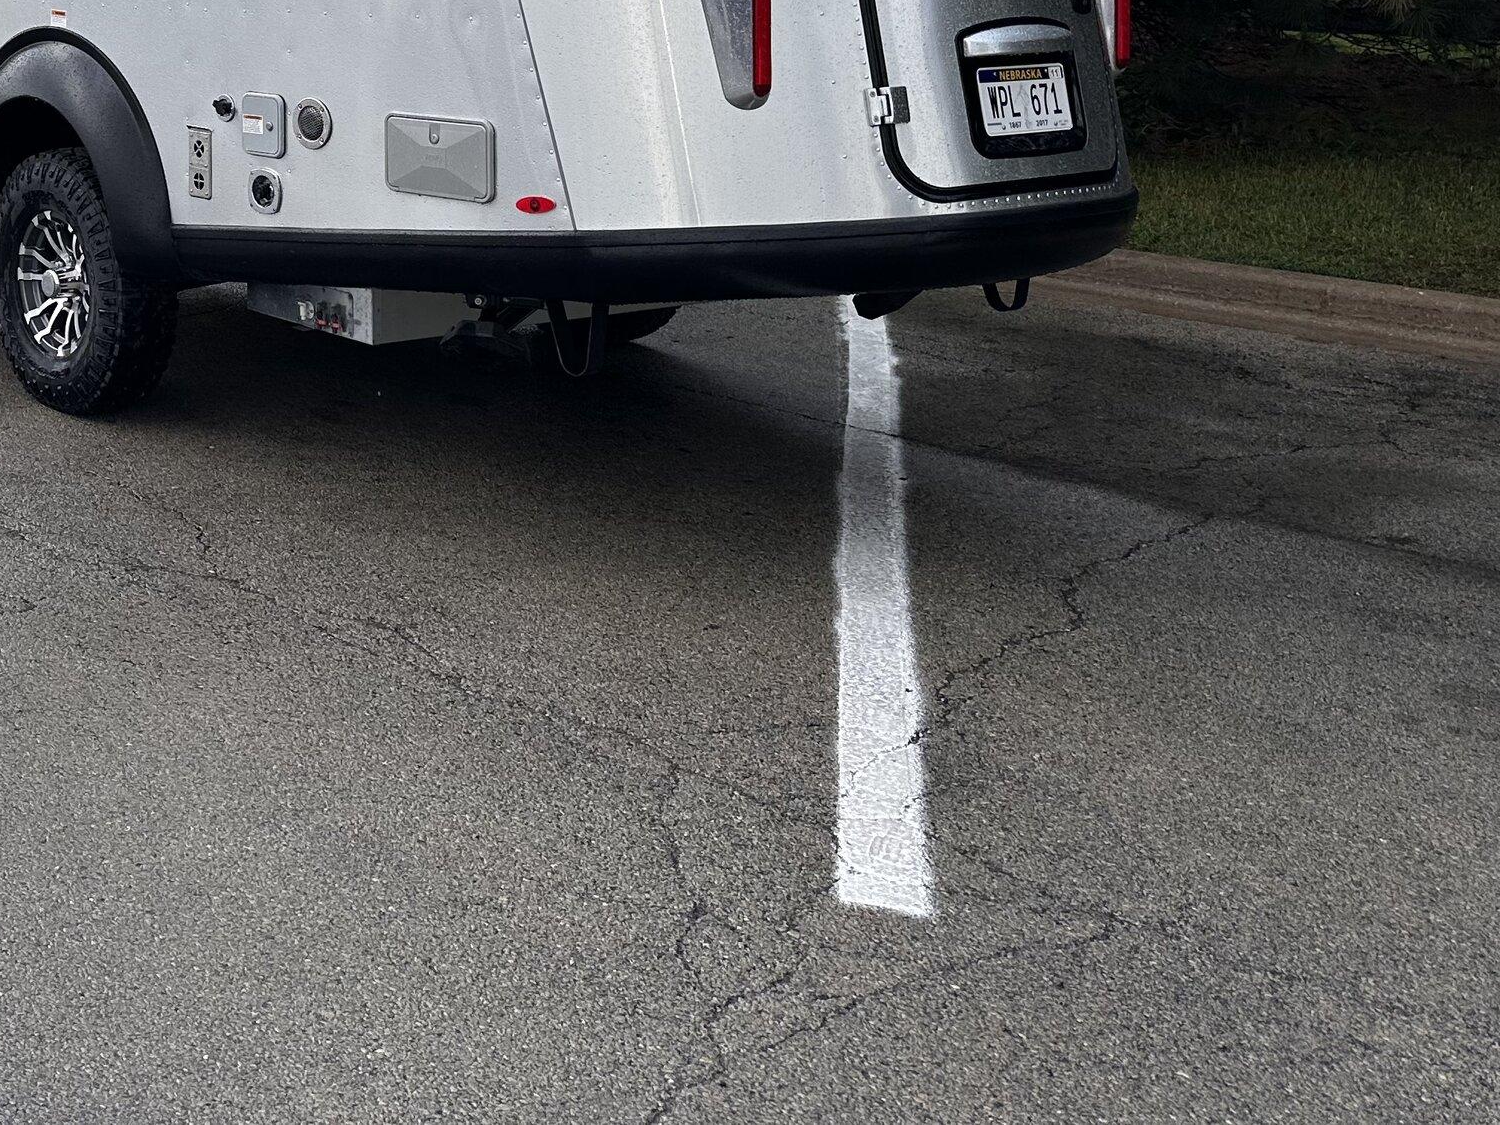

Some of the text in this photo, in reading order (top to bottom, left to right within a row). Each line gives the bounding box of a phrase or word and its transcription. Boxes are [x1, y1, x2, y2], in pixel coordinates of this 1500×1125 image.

[998, 68, 1043, 81] NEBRASKA
[987, 81, 1063, 119] WPL 671
